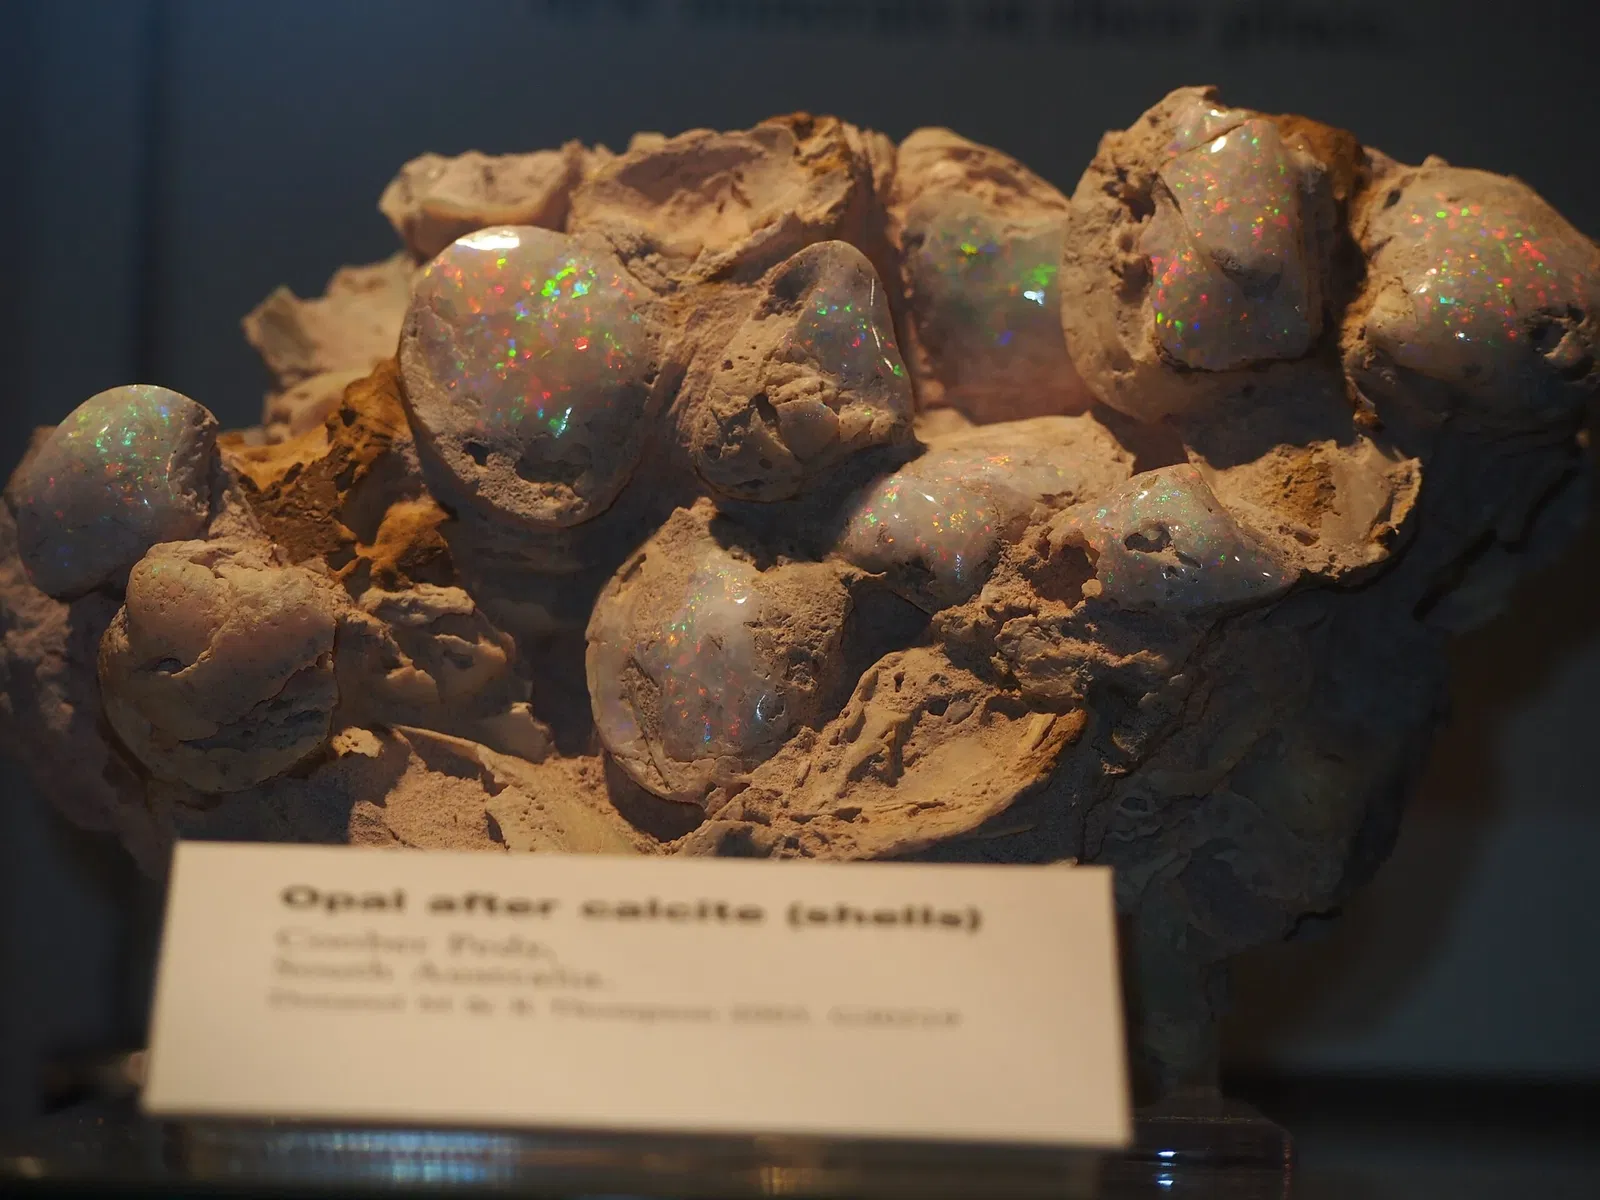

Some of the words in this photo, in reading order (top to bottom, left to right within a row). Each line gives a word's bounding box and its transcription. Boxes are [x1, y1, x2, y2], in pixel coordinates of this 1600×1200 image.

[279, 885, 407, 918] Opal
[427, 891, 559, 919] after
[580, 896, 767, 925] calcite
[786, 901, 983, 935] (shells)
